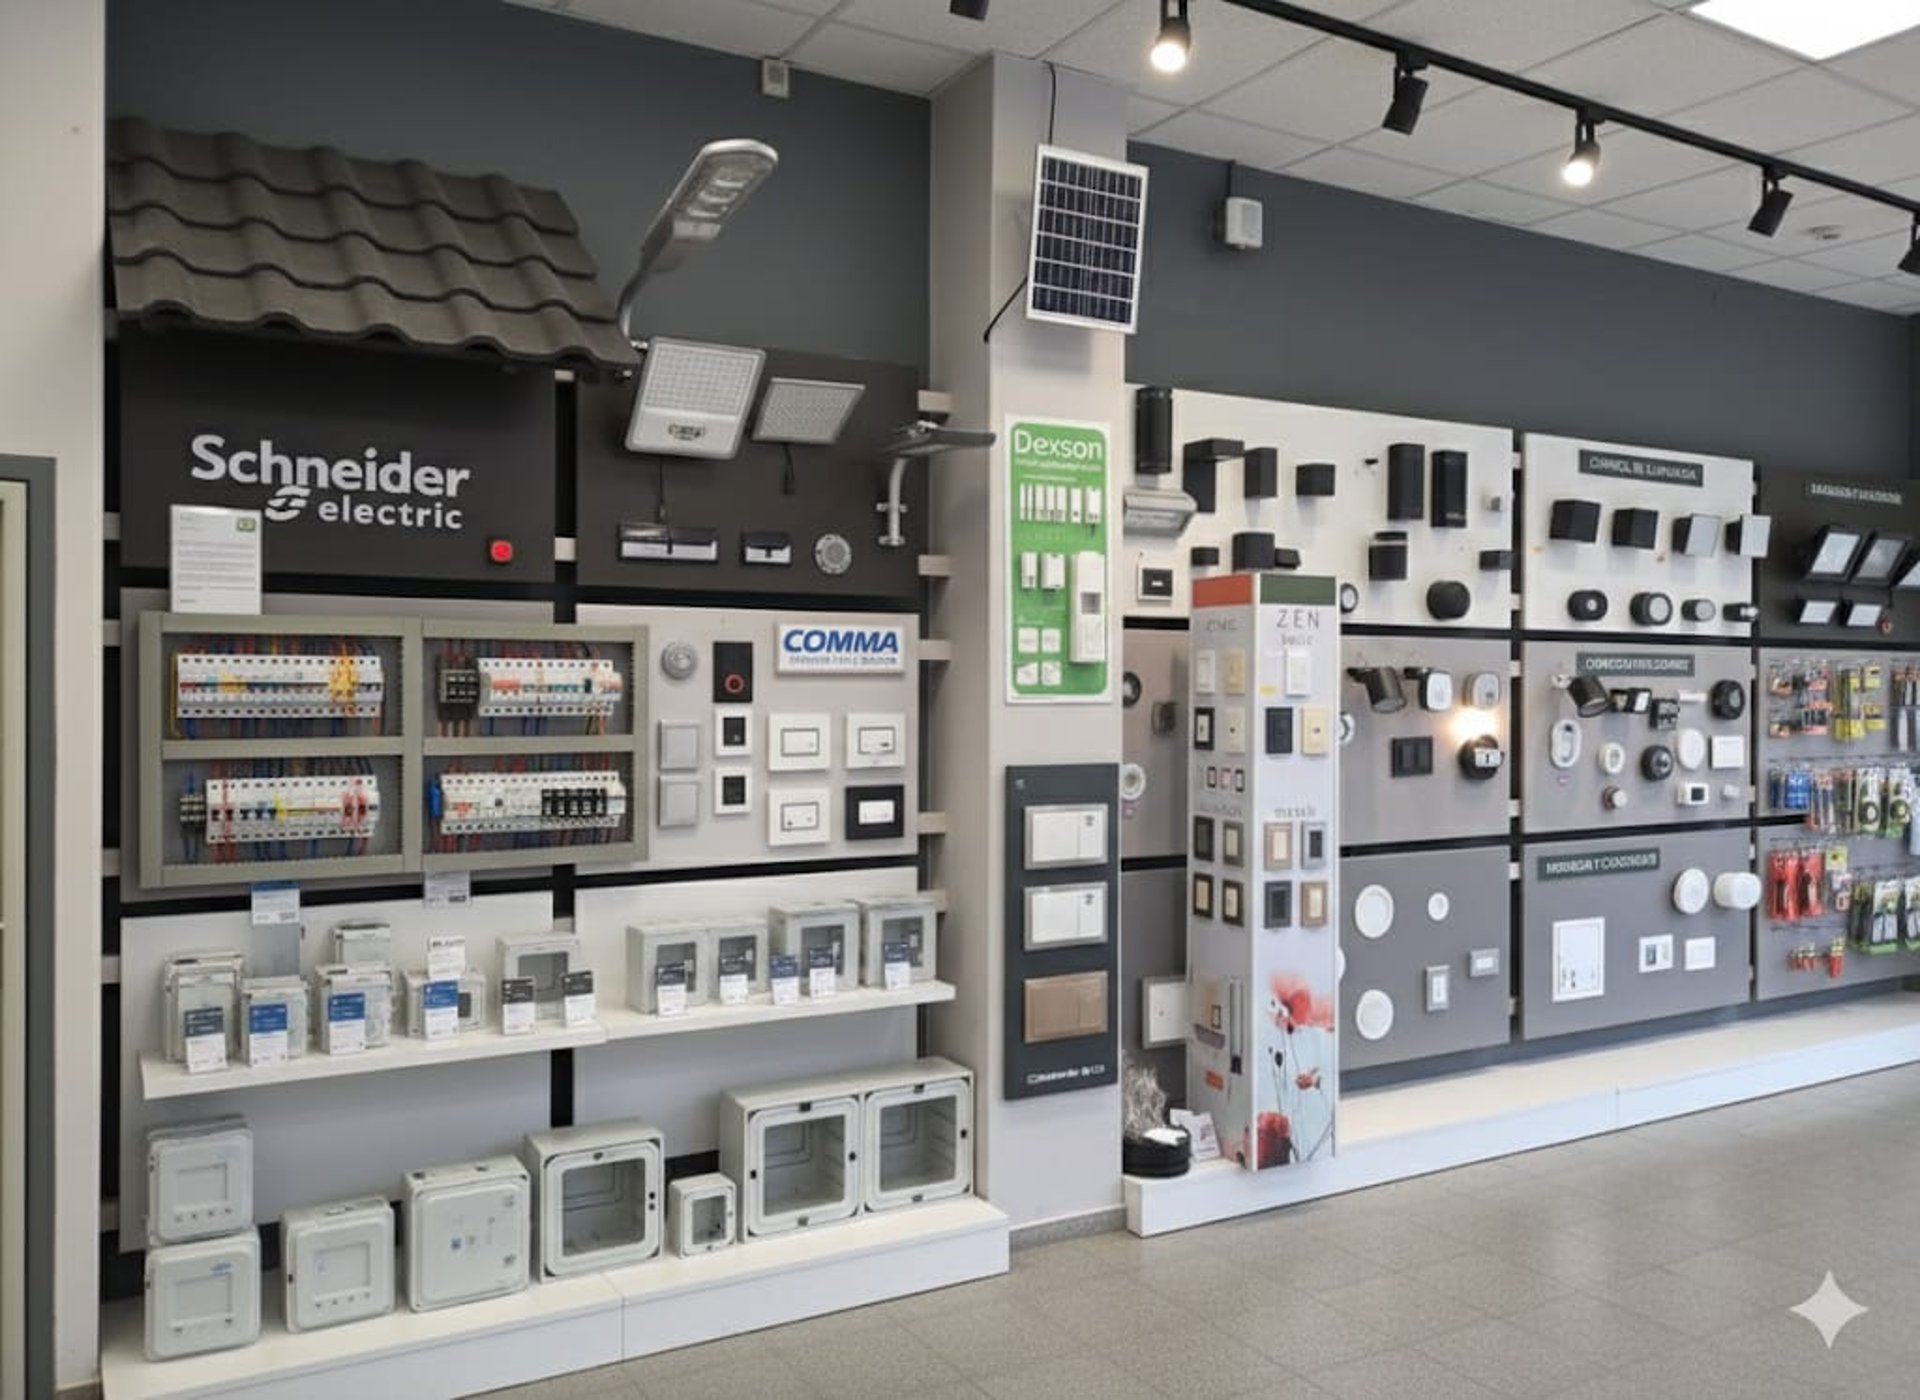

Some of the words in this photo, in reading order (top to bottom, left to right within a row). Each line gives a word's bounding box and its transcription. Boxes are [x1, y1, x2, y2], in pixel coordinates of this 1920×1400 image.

[1013, 428, 1103, 461] Dexson
[191, 433, 470, 497] Schneider
[317, 494, 463, 529] electric
[1276, 608, 1319, 630] ZEN
[783, 628, 899, 654] COMMA
